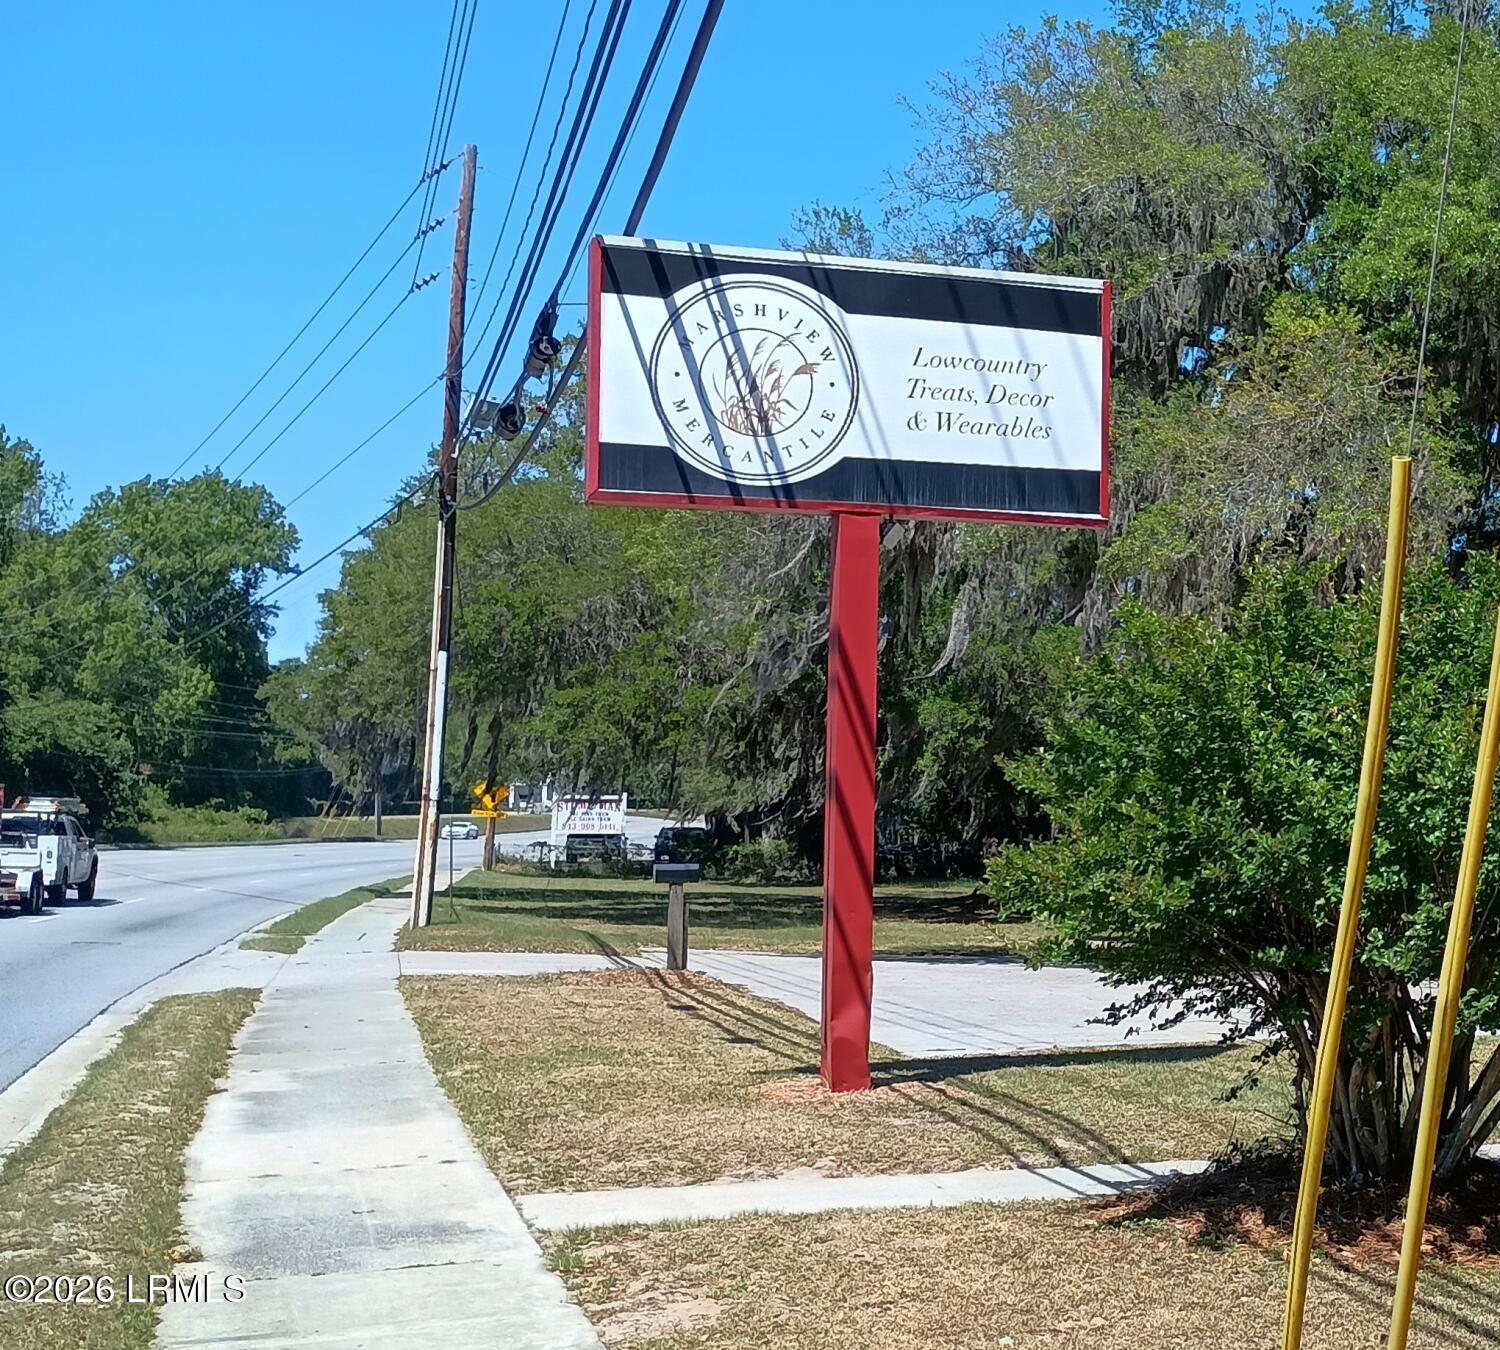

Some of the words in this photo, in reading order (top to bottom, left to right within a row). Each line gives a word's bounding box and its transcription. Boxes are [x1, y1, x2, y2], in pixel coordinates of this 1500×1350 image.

[678, 302, 837, 363] MARSHVIEW
[911, 346, 1049, 382] Lowcountry
[906, 377, 979, 406] Treats,
[984, 383, 1055, 408] Decor
[672, 398, 837, 465] MERCANTILE
[906, 409, 928, 432] &
[936, 410, 1053, 440] Wearables
